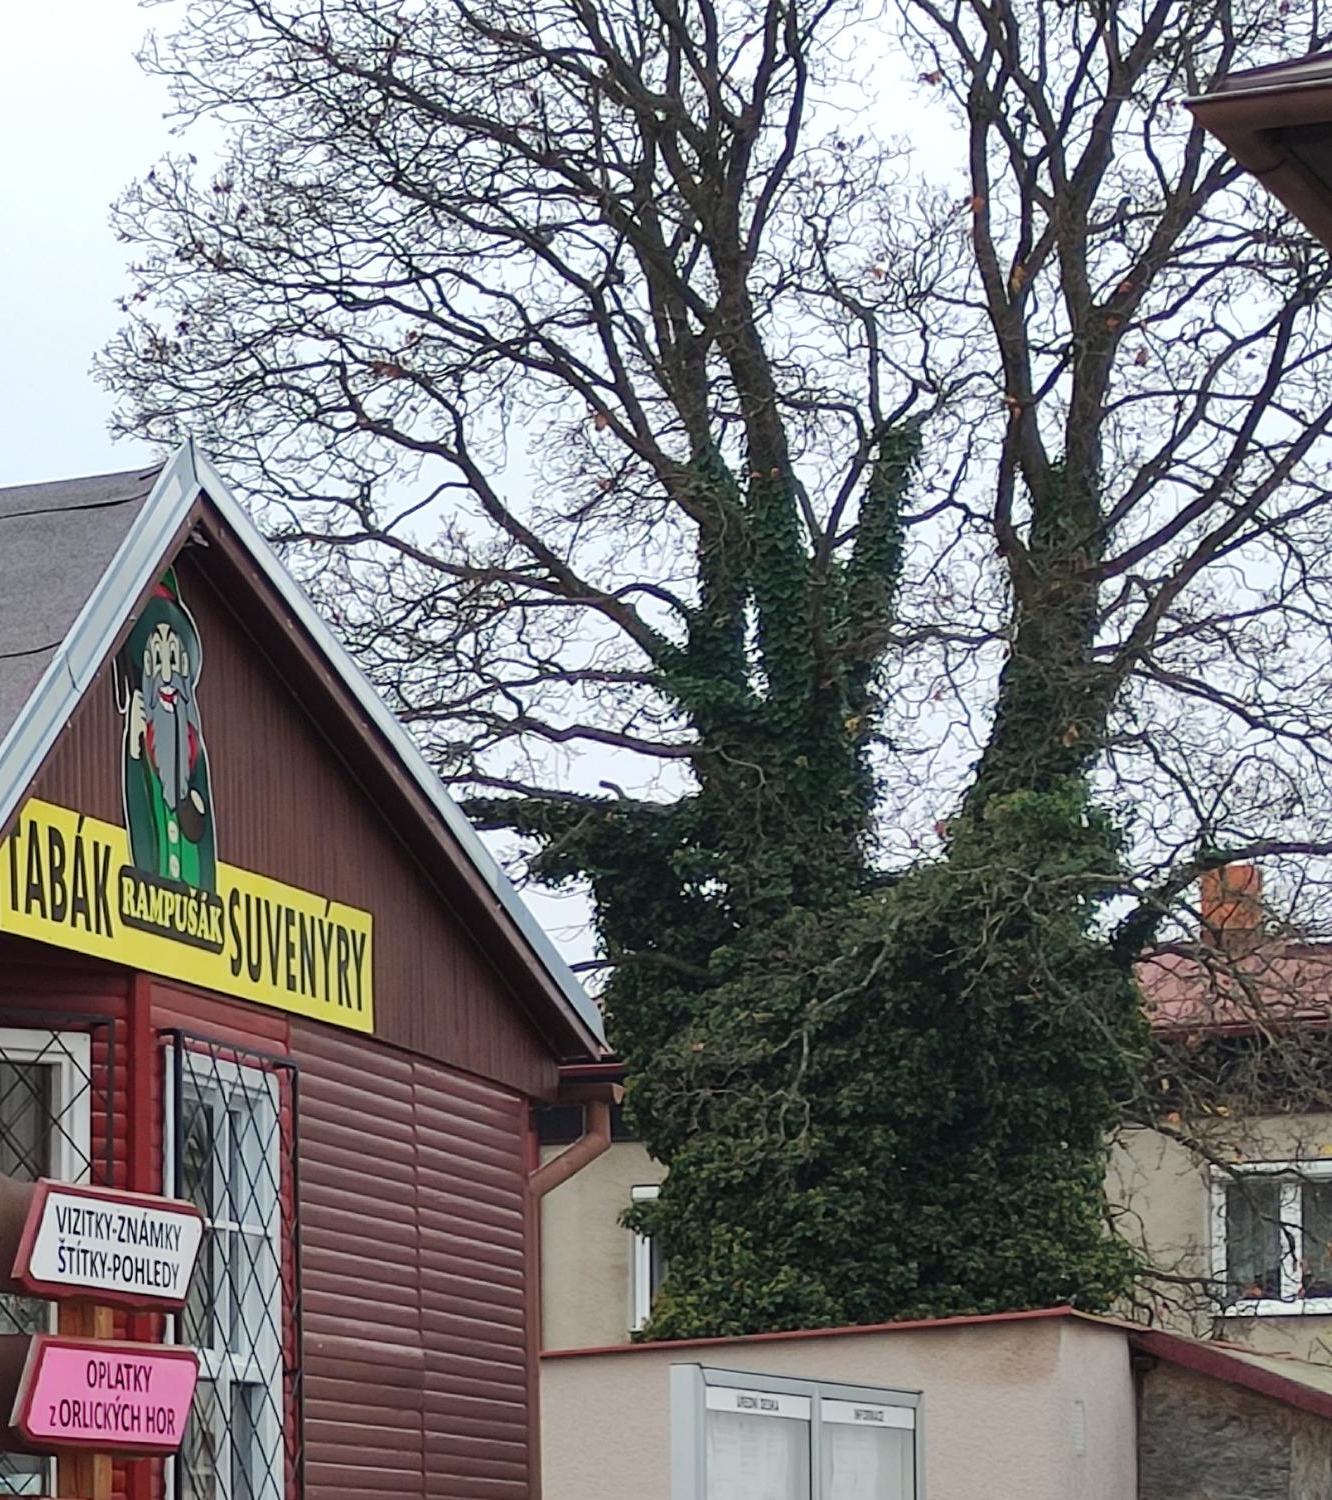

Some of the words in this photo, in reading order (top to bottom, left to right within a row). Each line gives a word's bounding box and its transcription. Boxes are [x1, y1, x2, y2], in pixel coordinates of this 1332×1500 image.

[7, 815, 114, 939] TABÁK
[228, 887, 367, 1012] SUVENÝRY
[121, 874, 225, 946] RAMPUŠÁK
[55, 1204, 183, 1252] VIZITKY-ZNÁMKY
[57, 1237, 180, 1290] ŠTÍTKY-POHLEDY
[87, 1359, 152, 1394] OPLATKY
[49, 1405, 56, 1427] z
[59, 1396, 139, 1434] ORLICKÝCH
[146, 1408, 176, 1436] HOR
